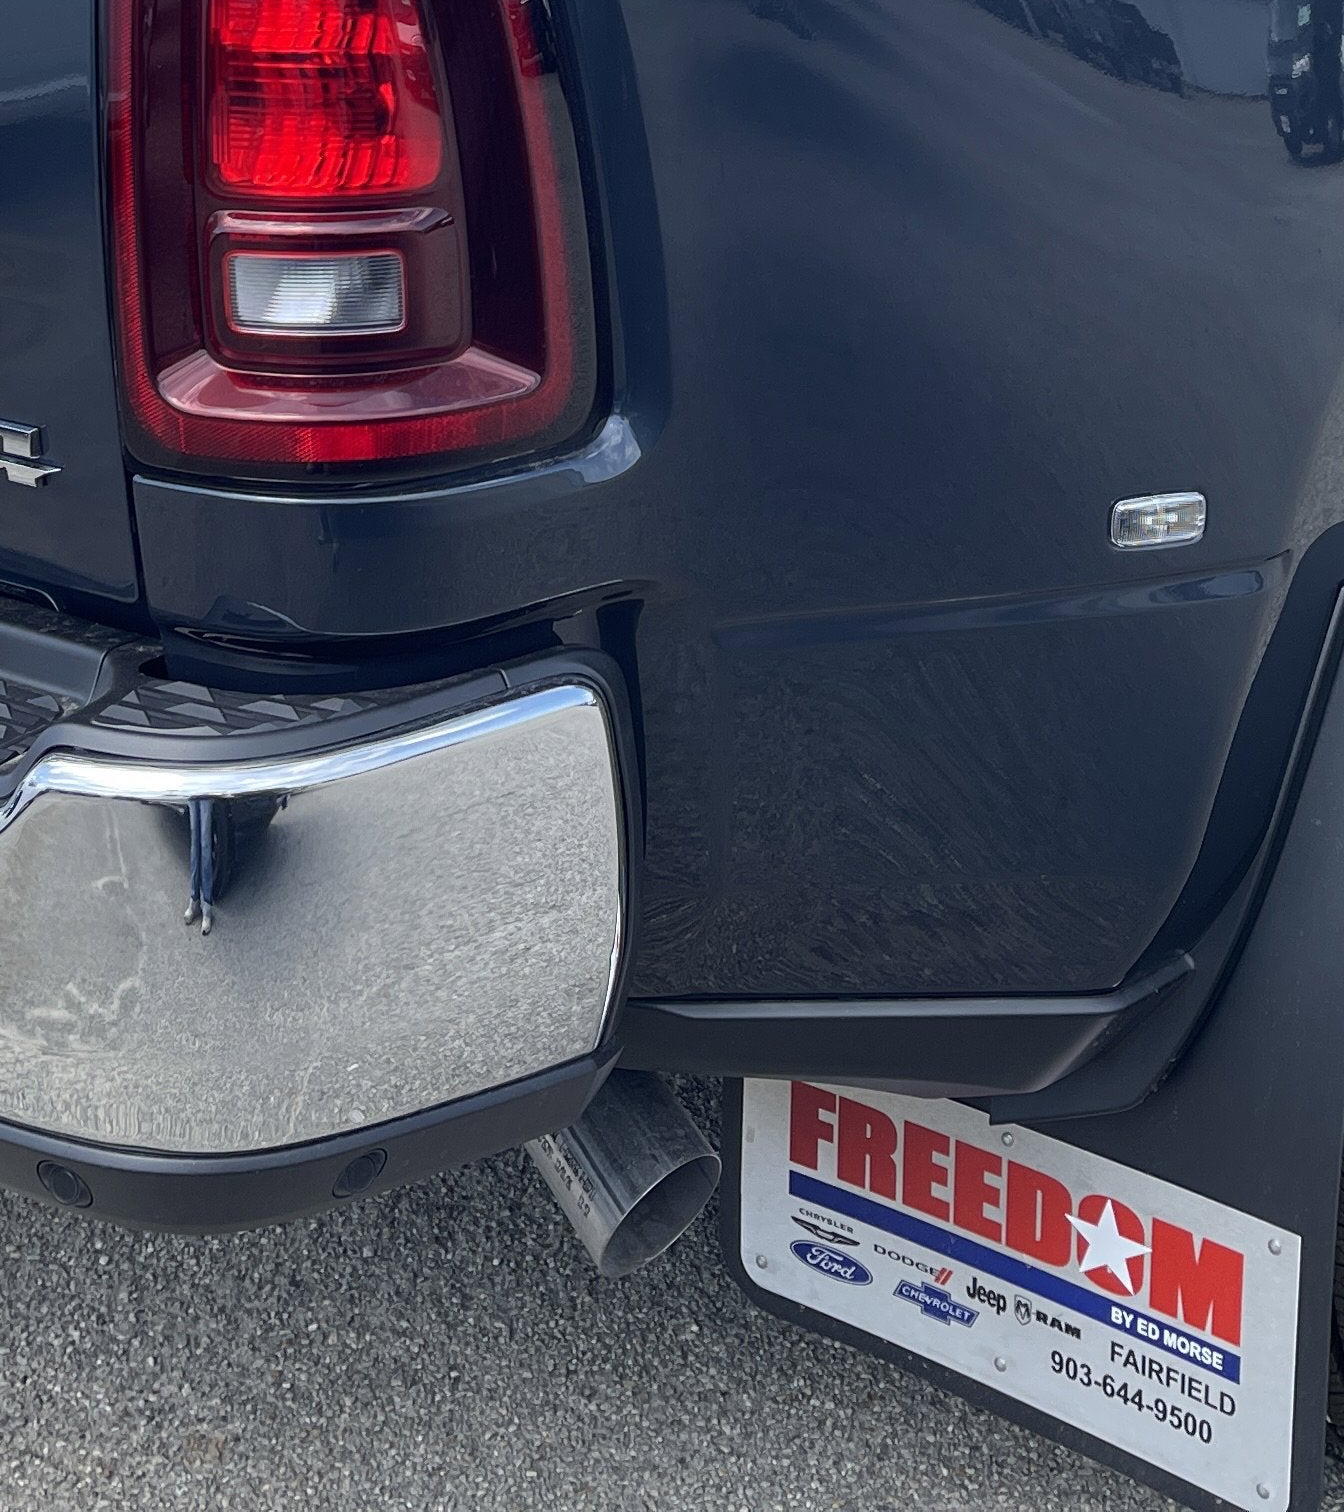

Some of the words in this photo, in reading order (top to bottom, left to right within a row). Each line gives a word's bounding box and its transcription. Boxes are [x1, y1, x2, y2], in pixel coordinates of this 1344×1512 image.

[789, 1080, 1245, 1348] FREEDOM
[798, 1206, 855, 1235] CHRYSLER
[806, 1245, 857, 1281] Ford
[873, 1243, 938, 1278] DODGE
[901, 1285, 972, 1322] CHEVROLET
[966, 1276, 1007, 1316] Jeep
[1035, 1312, 1082, 1341] RAM
[1110, 1305, 1134, 1330] BY
[1136, 1317, 1160, 1342] ED
[1163, 1328, 1224, 1372] MORSE
[1051, 1349, 1213, 1444] 903-644-9500
[1110, 1340, 1236, 1417] FAIRFIELD
